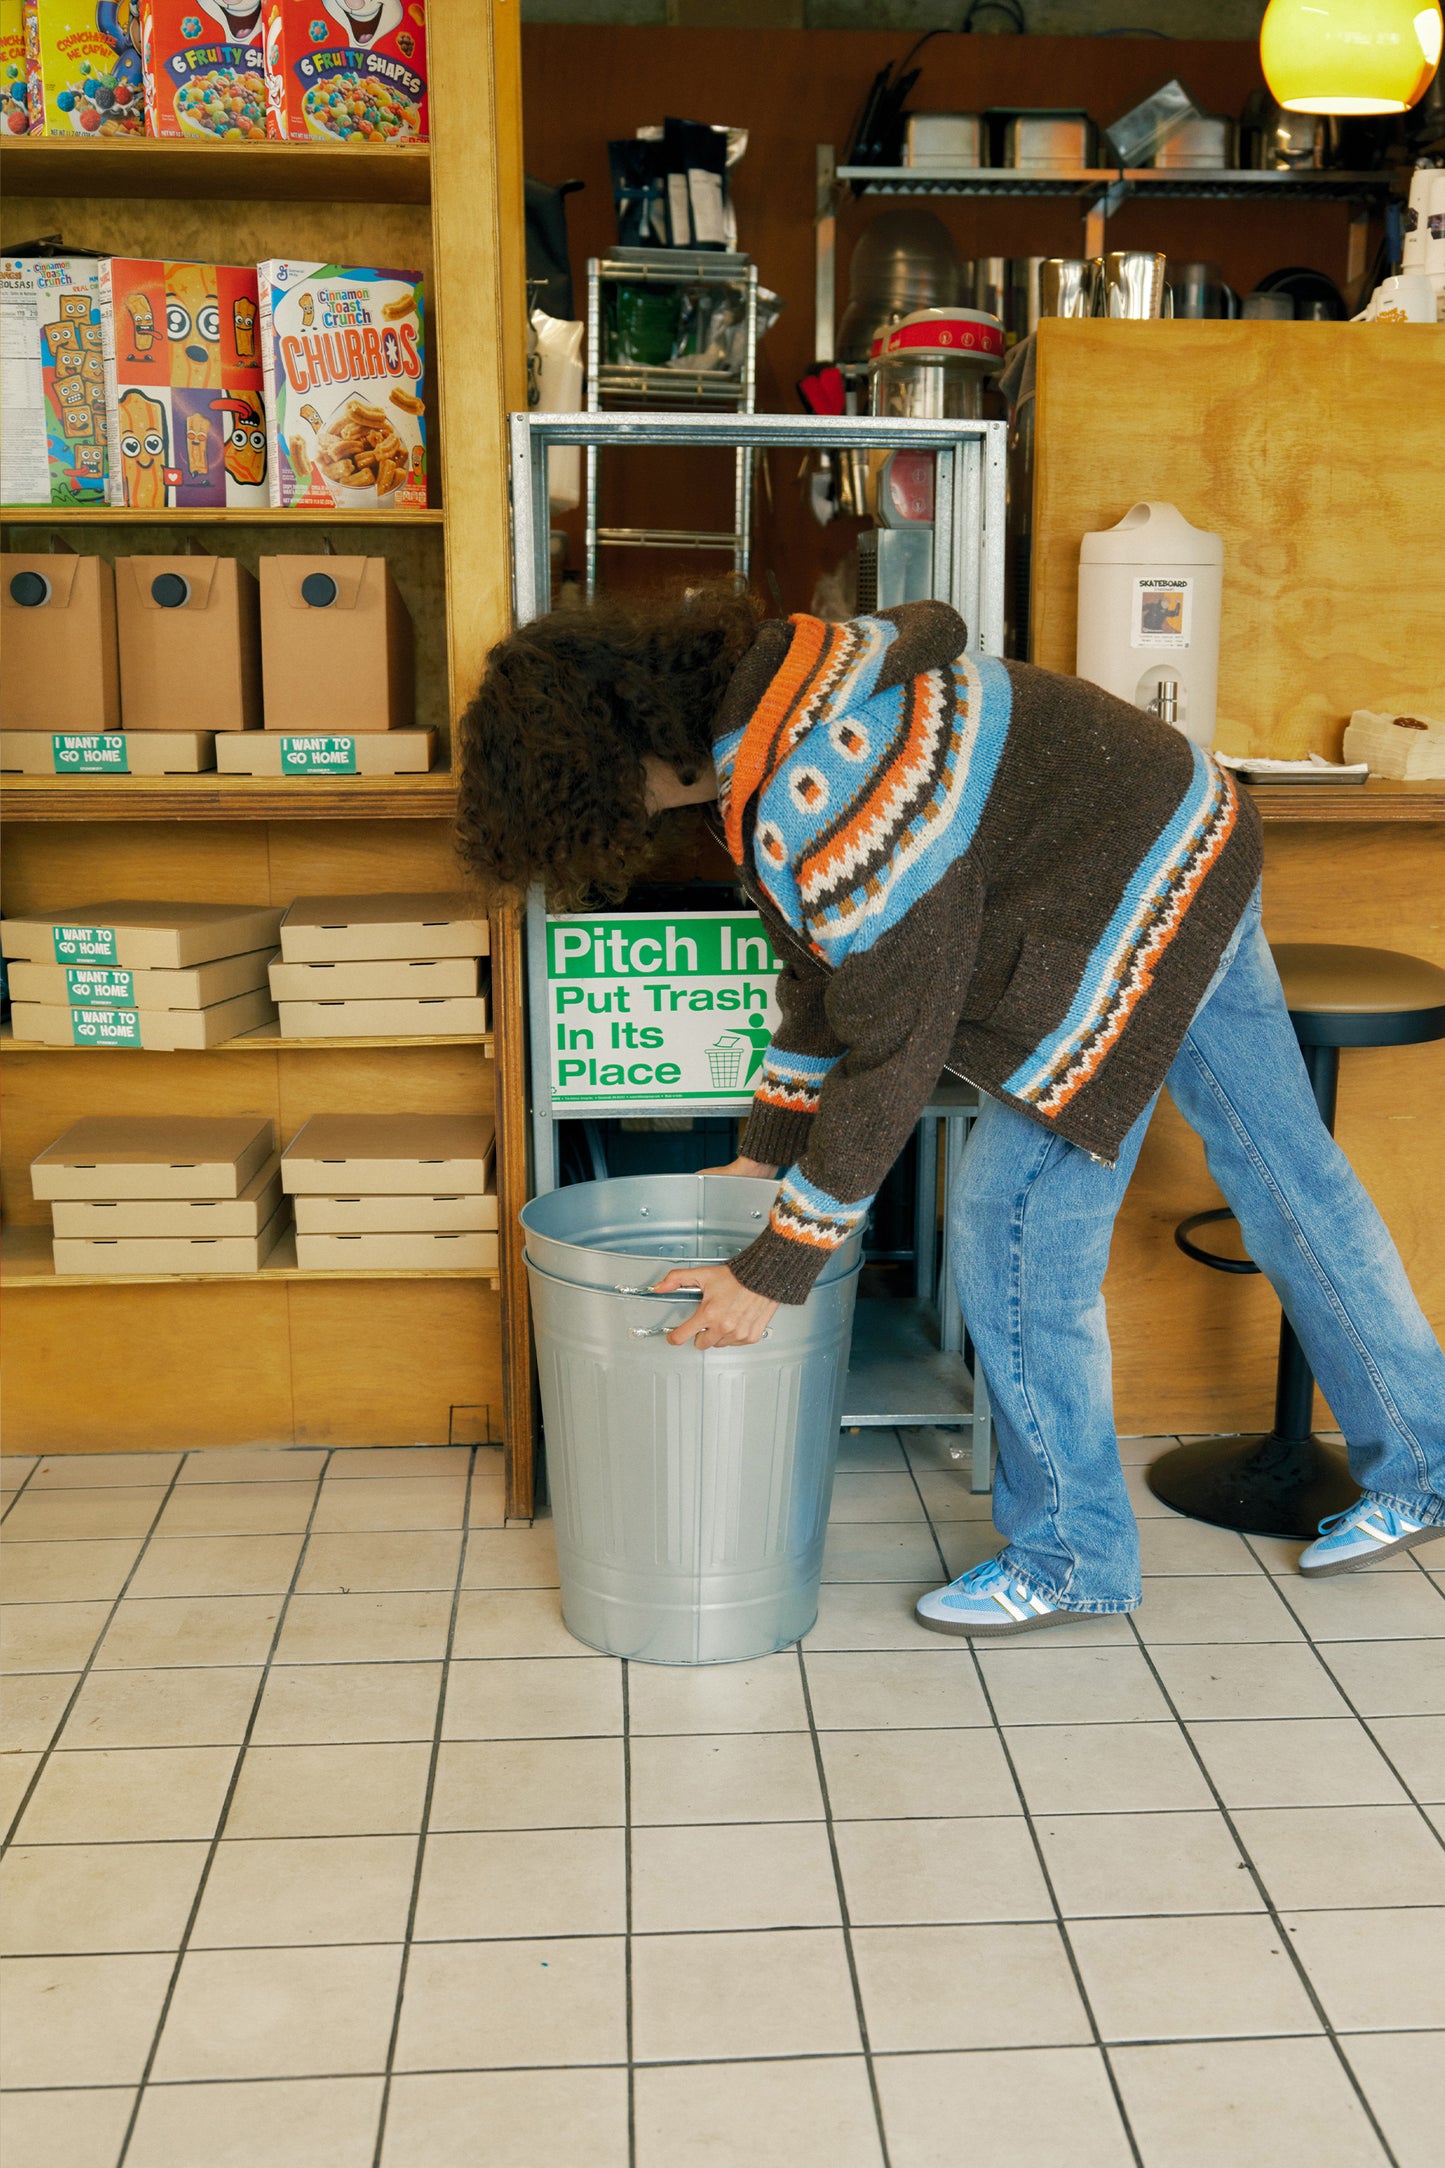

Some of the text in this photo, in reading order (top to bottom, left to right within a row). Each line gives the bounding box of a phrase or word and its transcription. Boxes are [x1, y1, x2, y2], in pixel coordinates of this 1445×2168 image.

[66, 47, 82, 61] ME
[172, 56, 187, 73] 6
[184, 46, 242, 70] FRUITY
[300, 50, 421, 93] 6 FRUITY SHAPES
[34, 262, 71, 272] Cinnamon
[41, 268, 65, 279] Toast
[38, 274, 72, 288] Crunch
[319, 289, 369, 302] Cinnamon
[329, 300, 361, 314] Toast
[323, 309, 371, 327] Crunch
[281, 323, 420, 393] CHURROS
[55, 736, 122, 749] I WANT TO
[283, 738, 351, 751] I WANT TO
[59, 750, 121, 762] GO HOME
[287, 752, 349, 764] GO HOME
[55, 928, 112, 942] I WANT TO
[59, 942, 112, 955] GO HOME
[554, 925, 783, 974] Pitch In.
[68, 970, 130, 984] I WANT TO
[72, 984, 129, 997] GO HOME
[555, 982, 768, 1015] Put Trash
[74, 1011, 136, 1024] I WANT TO
[78, 1024, 135, 1037] GO HOME
[557, 1022, 664, 1051] In Its
[558, 1058, 682, 1087] Place
